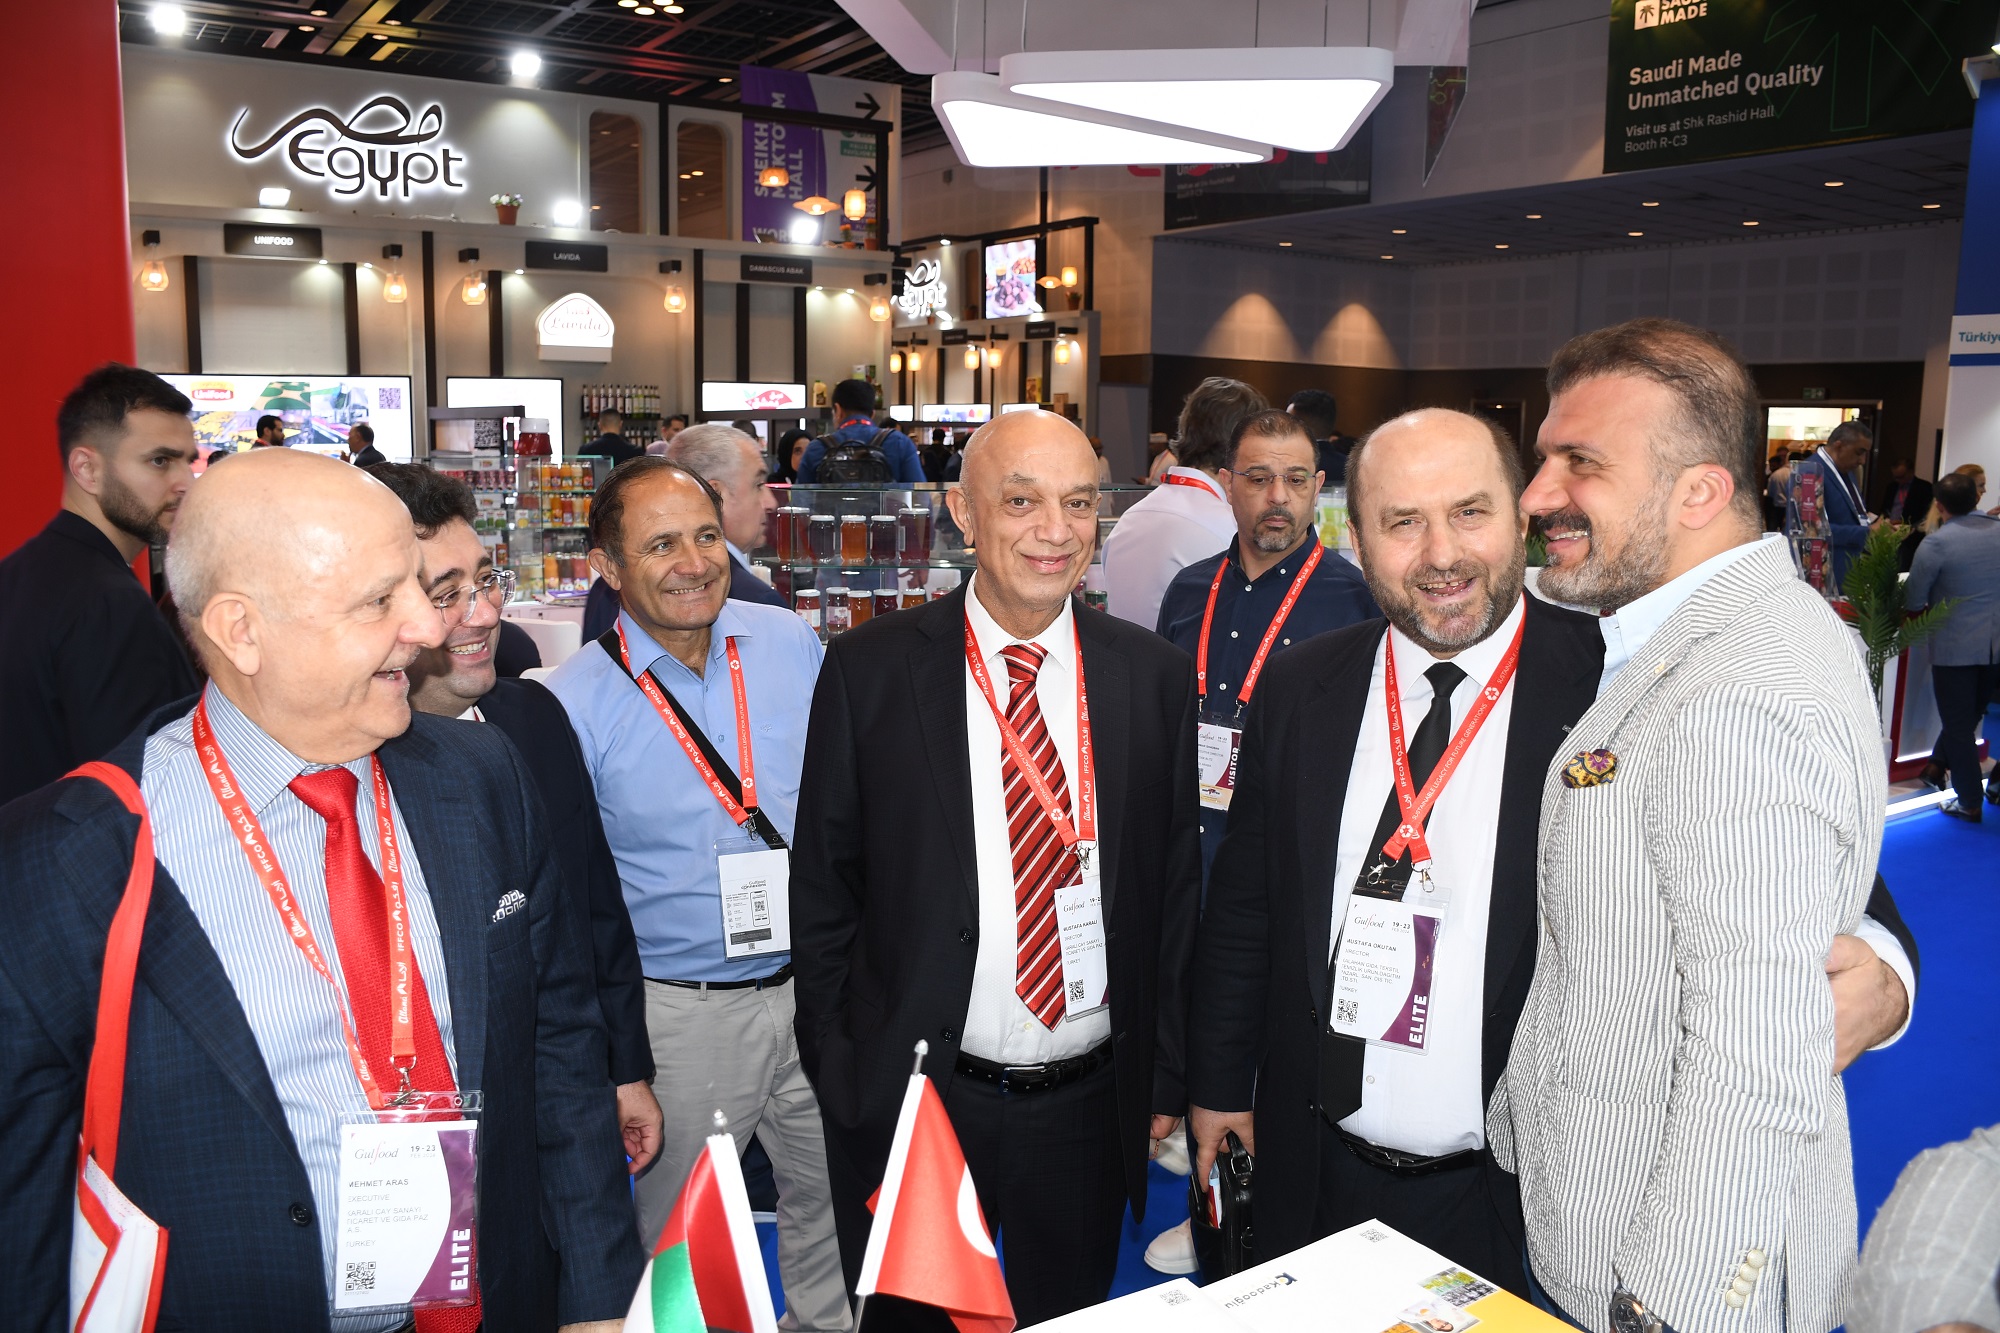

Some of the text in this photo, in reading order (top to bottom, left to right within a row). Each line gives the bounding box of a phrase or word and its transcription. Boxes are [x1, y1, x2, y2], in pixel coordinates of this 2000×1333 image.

[1660, 3, 1708, 25] MADE
[1629, 50, 1742, 85] Saudi Made
[1628, 64, 1824, 110] Unmatched Quality
[1626, 105, 1775, 137] Visit us at Shk Rashid Hall
[771, 92, 786, 199] MKTOM
[1625, 135, 1688, 152] Booth R-C3
[289, 129, 463, 197] Egypt
[754, 122, 769, 197] SEIKH
[789, 148, 804, 199] HALL
[254, 235, 294, 246] UNIFOOD
[553, 252, 581, 261] LAVIDA
[979, 676, 989, 695] IFFCO
[1020, 755, 1035, 775] LEGACY
[1228, 747, 1240, 786] VISITOR
[1411, 786, 1435, 821] SUSTAINABLE
[1431, 767, 1448, 789] LEGACY
[1444, 756, 1455, 769] FOR
[1450, 736, 1467, 758] FUTURE
[1462, 701, 1487, 738] GENERATIONS
[1399, 766, 1407, 787] IFFCO
[379, 783, 387, 809] IFFCO
[254, 844, 274, 873] IFFCO
[1354, 914, 1384, 930] Gulfood
[396, 924, 404, 951] IFFCO
[398, 996, 408, 1024] Allana
[1409, 994, 1428, 1044] ELITE
[354, 1141, 399, 1165] Gulfood
[386, 1179, 409, 1187] ARAS
[451, 1228, 471, 1291] ELITE
